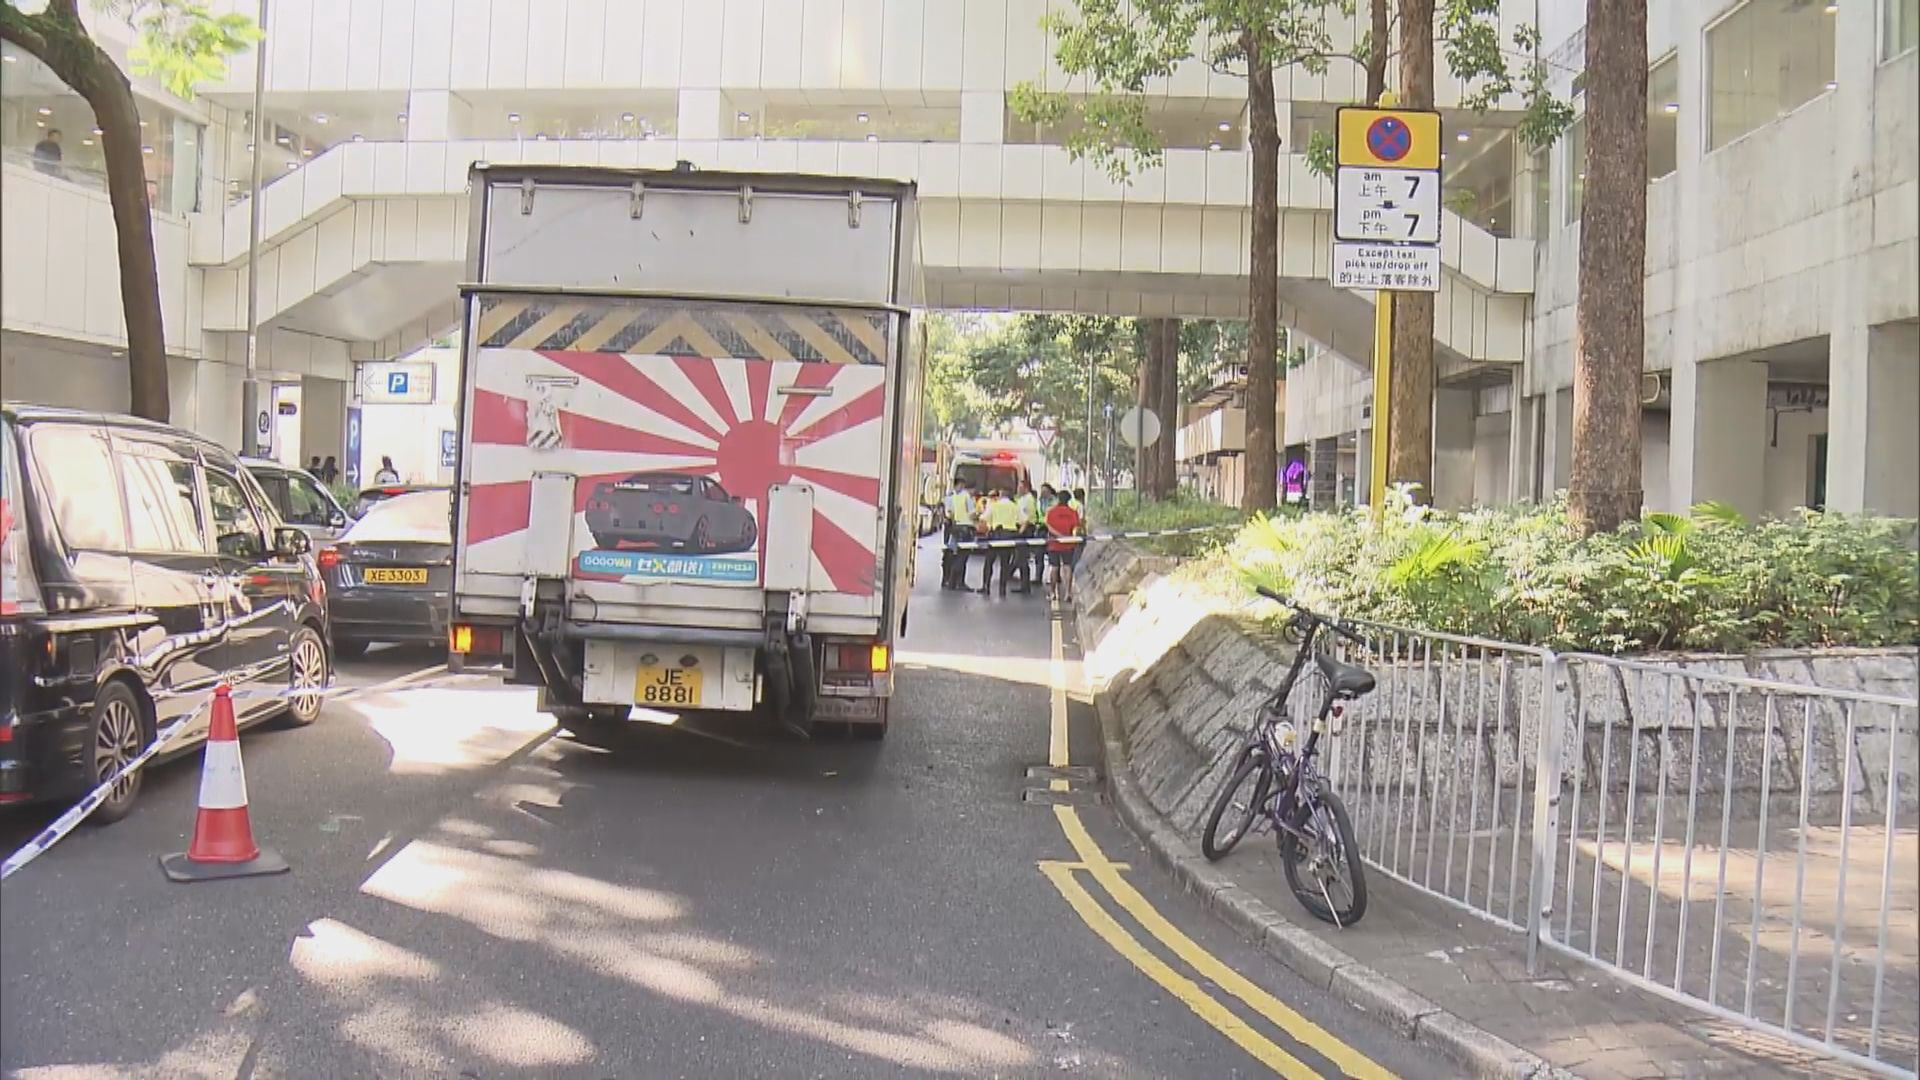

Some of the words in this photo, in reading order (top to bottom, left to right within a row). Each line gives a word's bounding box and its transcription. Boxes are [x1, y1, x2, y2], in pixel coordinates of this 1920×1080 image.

[1358, 183, 1388, 199] 上午
[1363, 172, 1382, 182] am
[1403, 175, 1420, 199] 7
[1358, 221, 1388, 236] 下午
[1363, 209, 1381, 220] pm
[1403, 213, 1420, 237] 7
[1358, 248, 1393, 259] Except
[1397, 249, 1416, 259] taxi
[1345, 259, 1366, 269] pick
[1369, 260, 1411, 271] up/drop
[1413, 261, 1428, 270] off
[1339, 271, 1432, 287] 的士上落客除外
[390, 373, 406, 392] P
[370, 570, 386, 581] XE
[388, 570, 420, 581] 3303
[656, 668, 683, 686] JE
[644, 685, 693, 704] 8881
